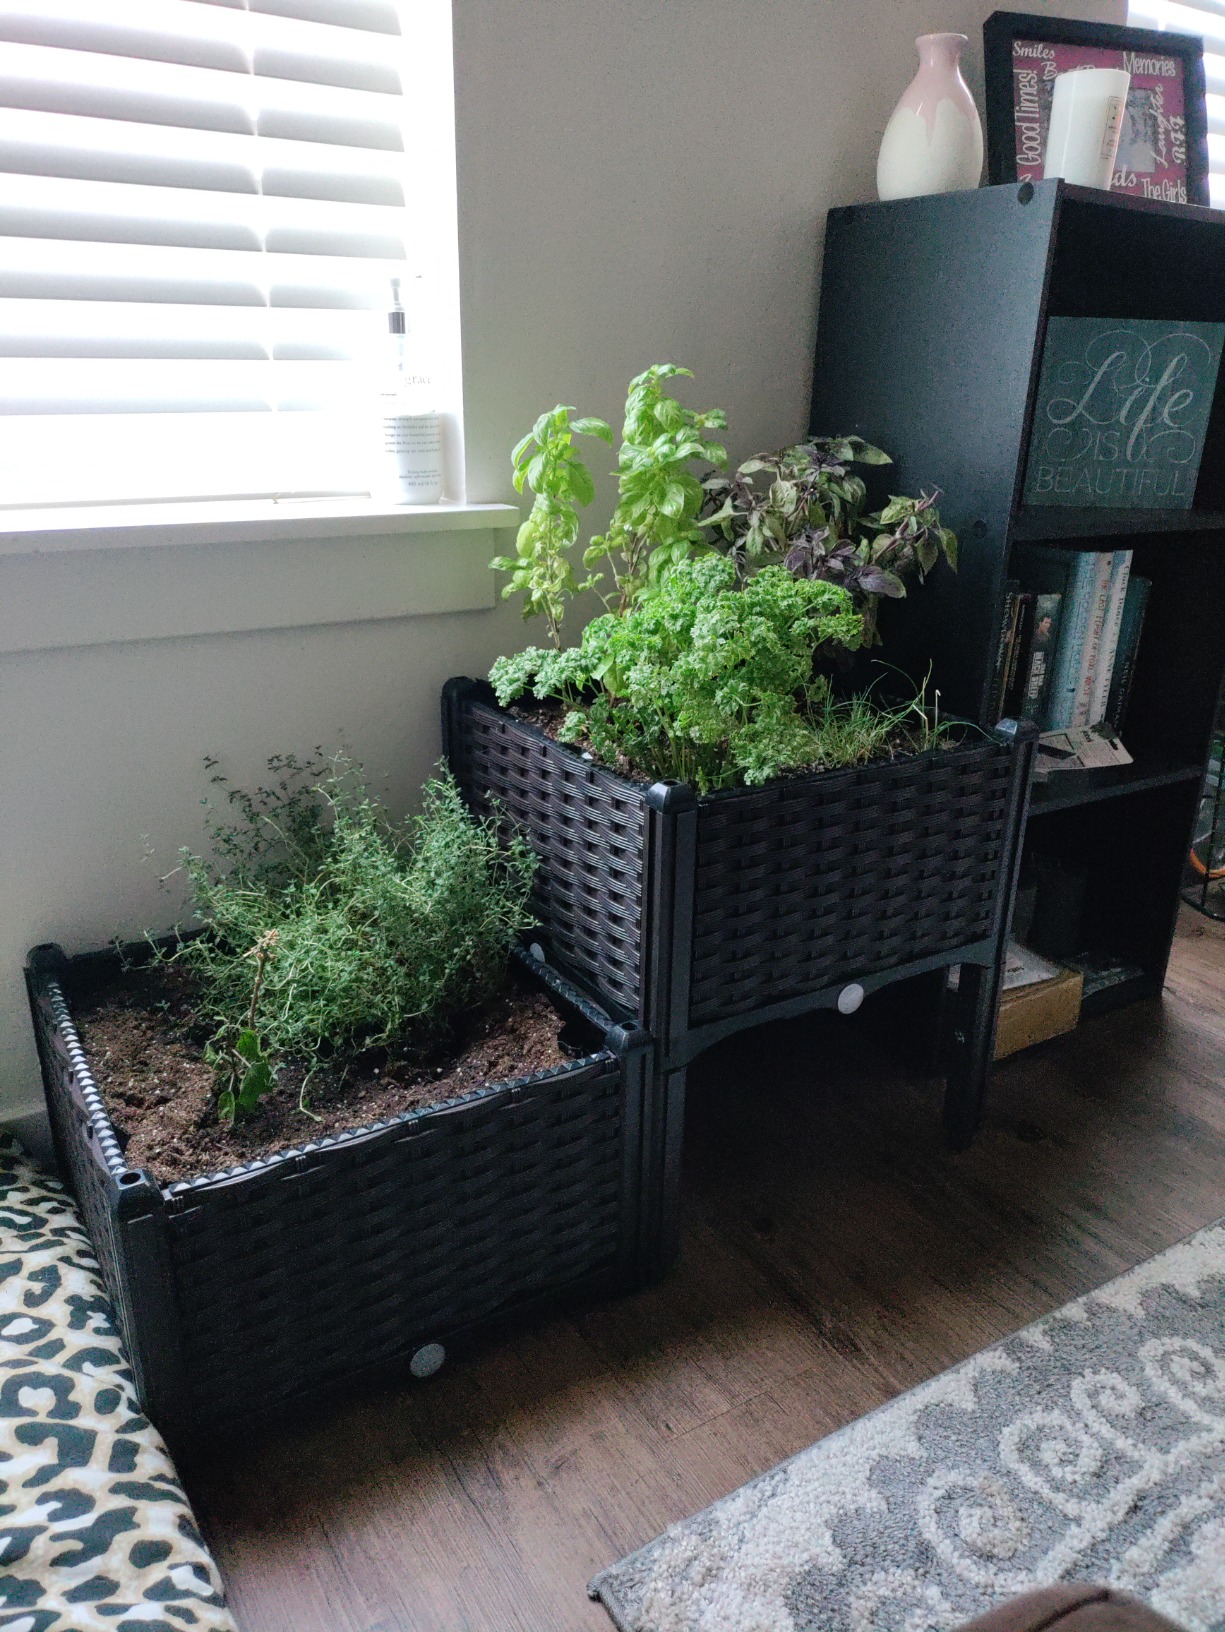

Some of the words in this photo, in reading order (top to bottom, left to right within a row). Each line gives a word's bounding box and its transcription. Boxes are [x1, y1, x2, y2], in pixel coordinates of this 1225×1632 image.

[1013, 40, 1055, 59] Smiles
[1123, 51, 1176, 77] Memories
[1013, 69, 1041, 125] Times!
[1016, 122, 1042, 166] Good
[1149, 84, 1171, 169] Laughter
[1162, 178, 1187, 205] Girls
[1047, 344, 1197, 463] Life
[1093, 430, 1121, 462] IS
[1036, 466, 1186, 496] BEAUTIFUL
[996, 592, 1013, 672] SHOWDOWN
